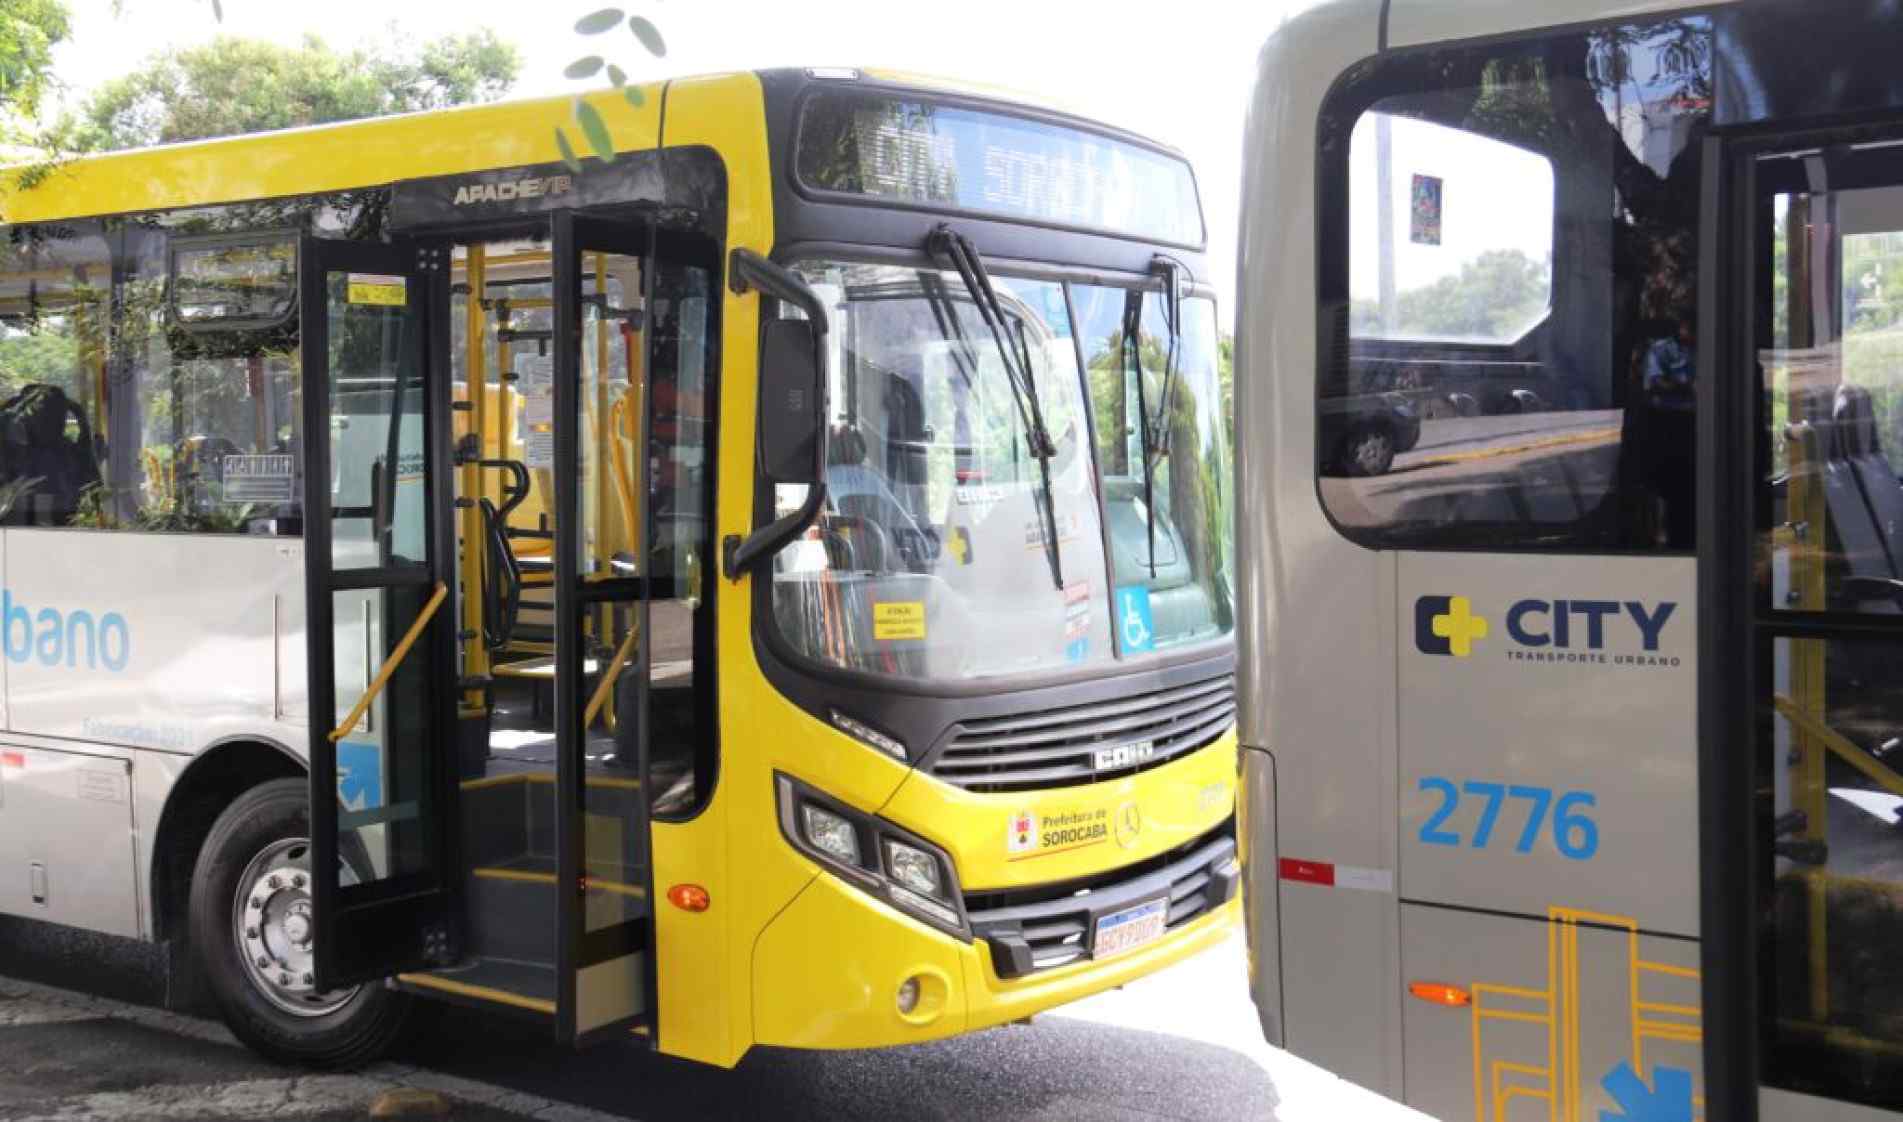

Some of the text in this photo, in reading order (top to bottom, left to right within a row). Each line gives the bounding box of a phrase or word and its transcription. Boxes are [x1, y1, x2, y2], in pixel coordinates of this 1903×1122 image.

[3, 589, 129, 672] bano
[1506, 599, 1677, 651] CITY
[1507, 651, 1681, 667] TRANSPORTE URBANO
[1042, 811, 1093, 829] Prefeitura
[1042, 824, 1107, 848] SOROCABA
[1418, 776, 1599, 861] 2776
